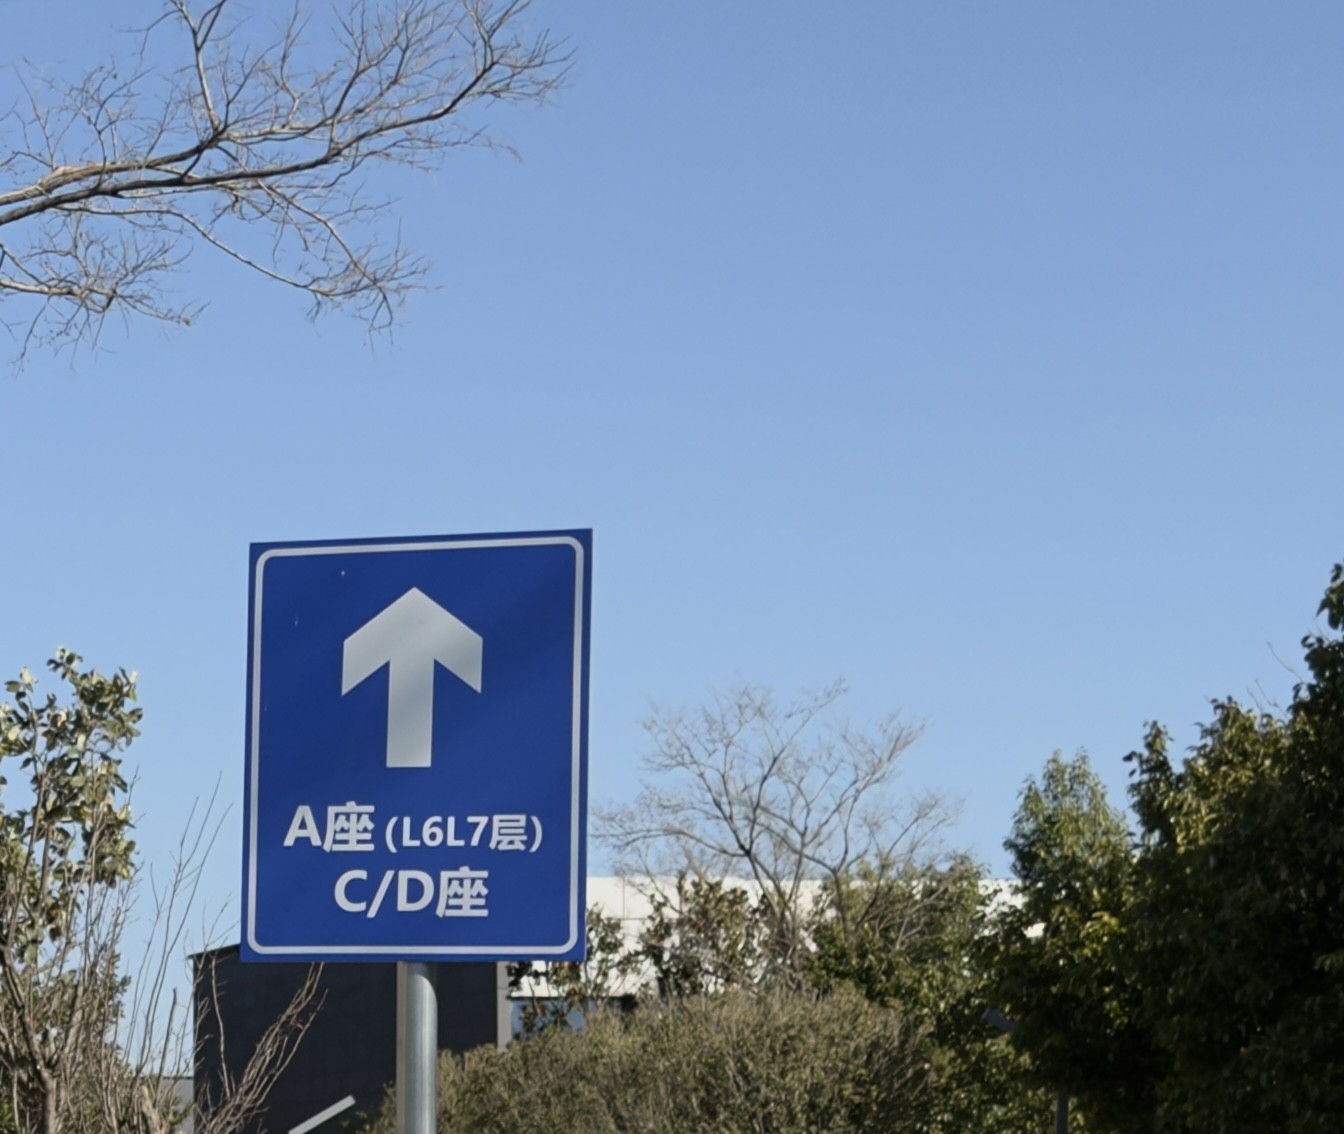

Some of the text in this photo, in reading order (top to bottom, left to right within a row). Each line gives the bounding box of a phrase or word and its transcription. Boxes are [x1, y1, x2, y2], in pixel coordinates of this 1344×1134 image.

[283, 801, 543, 853] A座 (L6L7层)
[334, 866, 489, 918] C/D座
